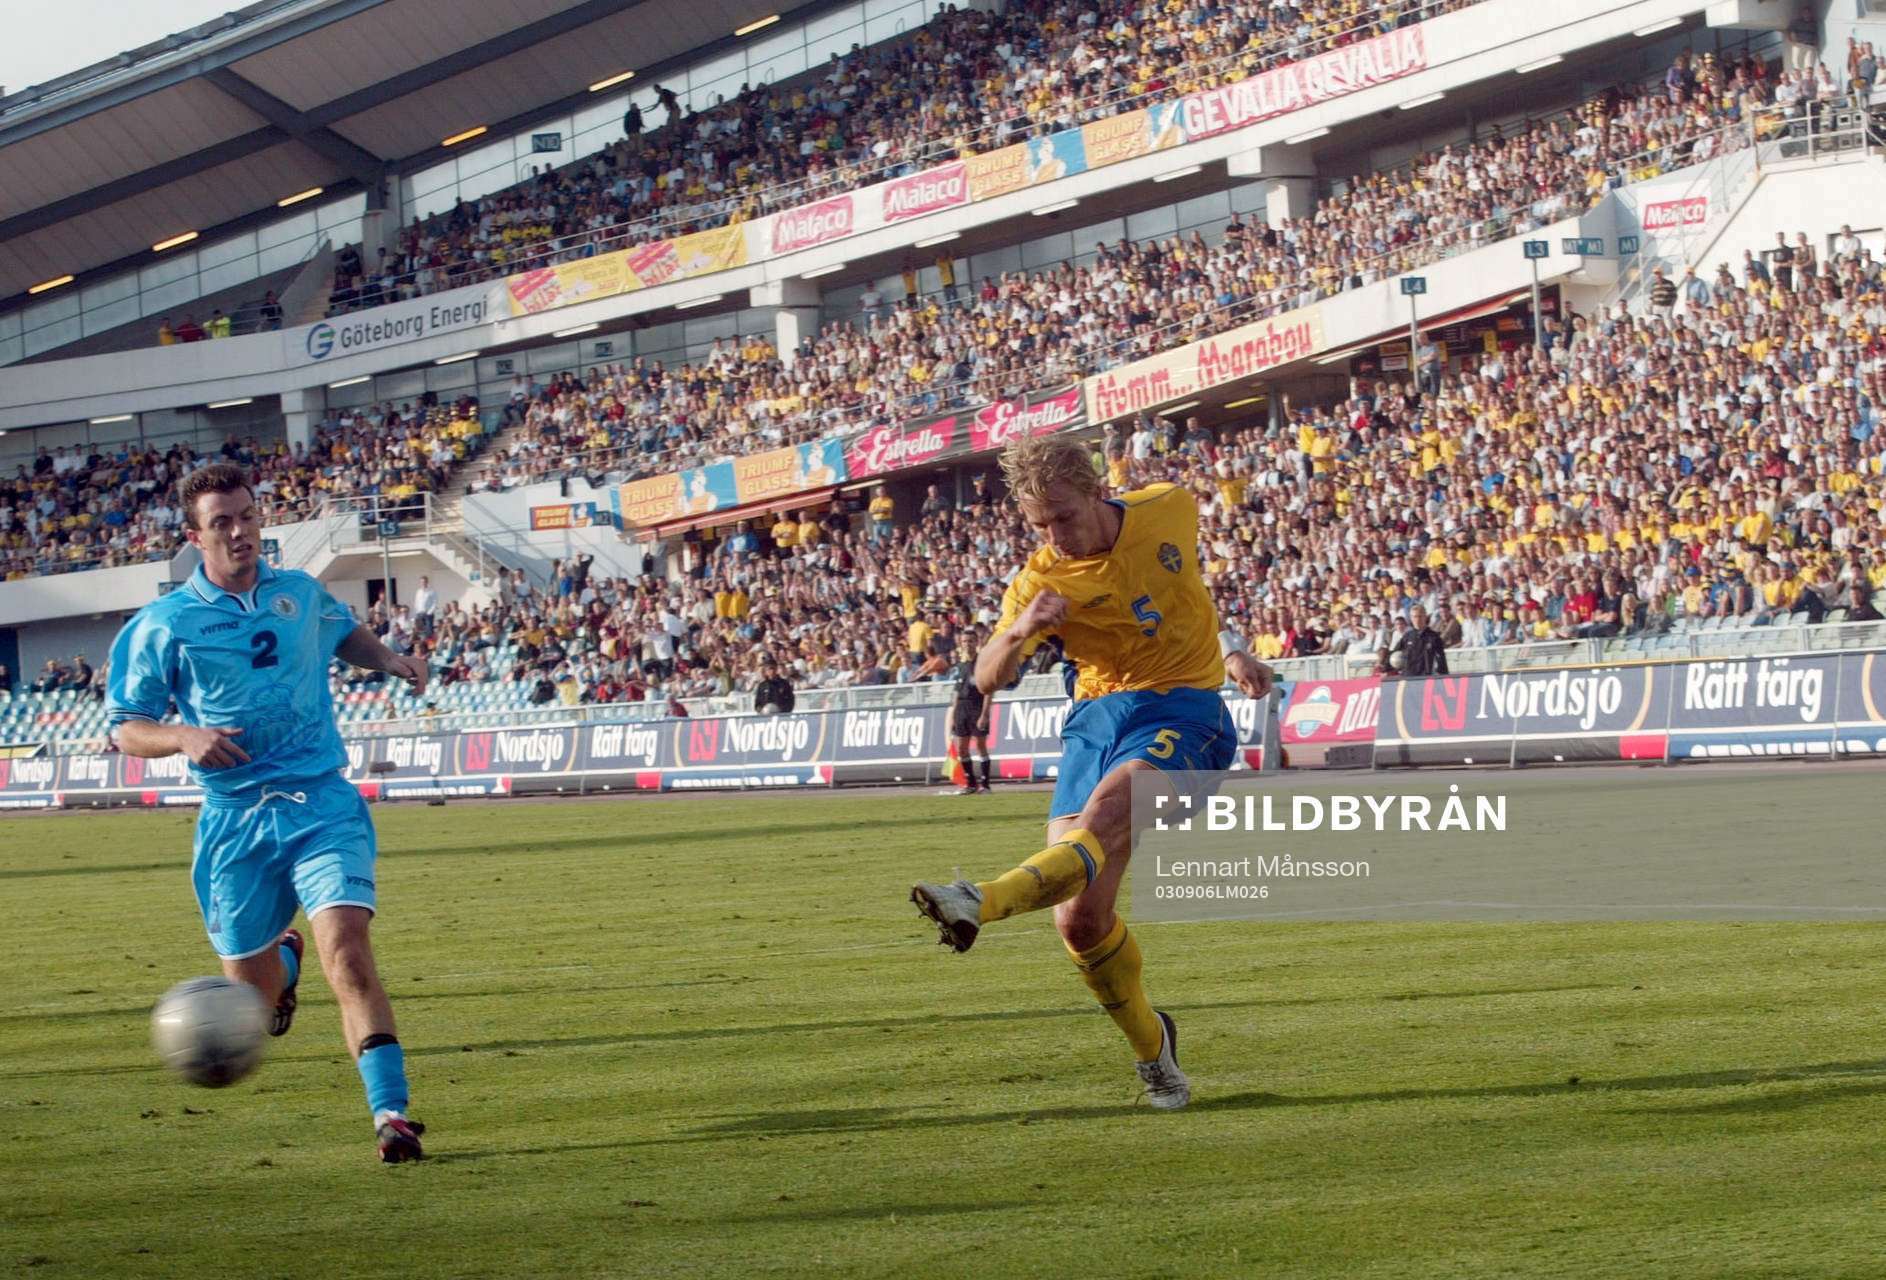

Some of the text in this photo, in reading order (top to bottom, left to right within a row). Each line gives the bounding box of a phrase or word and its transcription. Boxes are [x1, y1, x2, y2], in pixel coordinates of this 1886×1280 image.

[1184, 29, 1422, 135] GEVALIA GEVALIA
[889, 176, 961, 213] Malaco
[779, 209, 848, 246] Malaco
[1527, 242, 1545, 257] L3
[1404, 280, 1423, 294] L4
[341, 295, 488, 348] Göteborg Energi
[1197, 322, 1312, 388] Marabou
[991, 403, 1067, 443] Estrella
[742, 456, 794, 478] TRIUMF
[868, 429, 944, 471] Estrella
[624, 481, 677, 505] TRIUMF
[745, 474, 792, 496] GLASS
[381, 523, 396, 535] L5
[629, 500, 674, 521] GLASS
[1131, 594, 1163, 638] 5
[251, 630, 279, 669] 2
[1476, 669, 1622, 730] Nordsjö
[1684, 662, 1748, 710] Rätt
[722, 715, 809, 761] Nordsjö
[842, 710, 881, 747] Rätt
[1005, 700, 1073, 740] Nord
[386, 737, 412, 767] Rätt
[493, 729, 565, 771] Nordsjö
[591, 723, 623, 758] Rätt
[1147, 728, 1182, 759] 5
[144, 753, 189, 785] Nordsj
